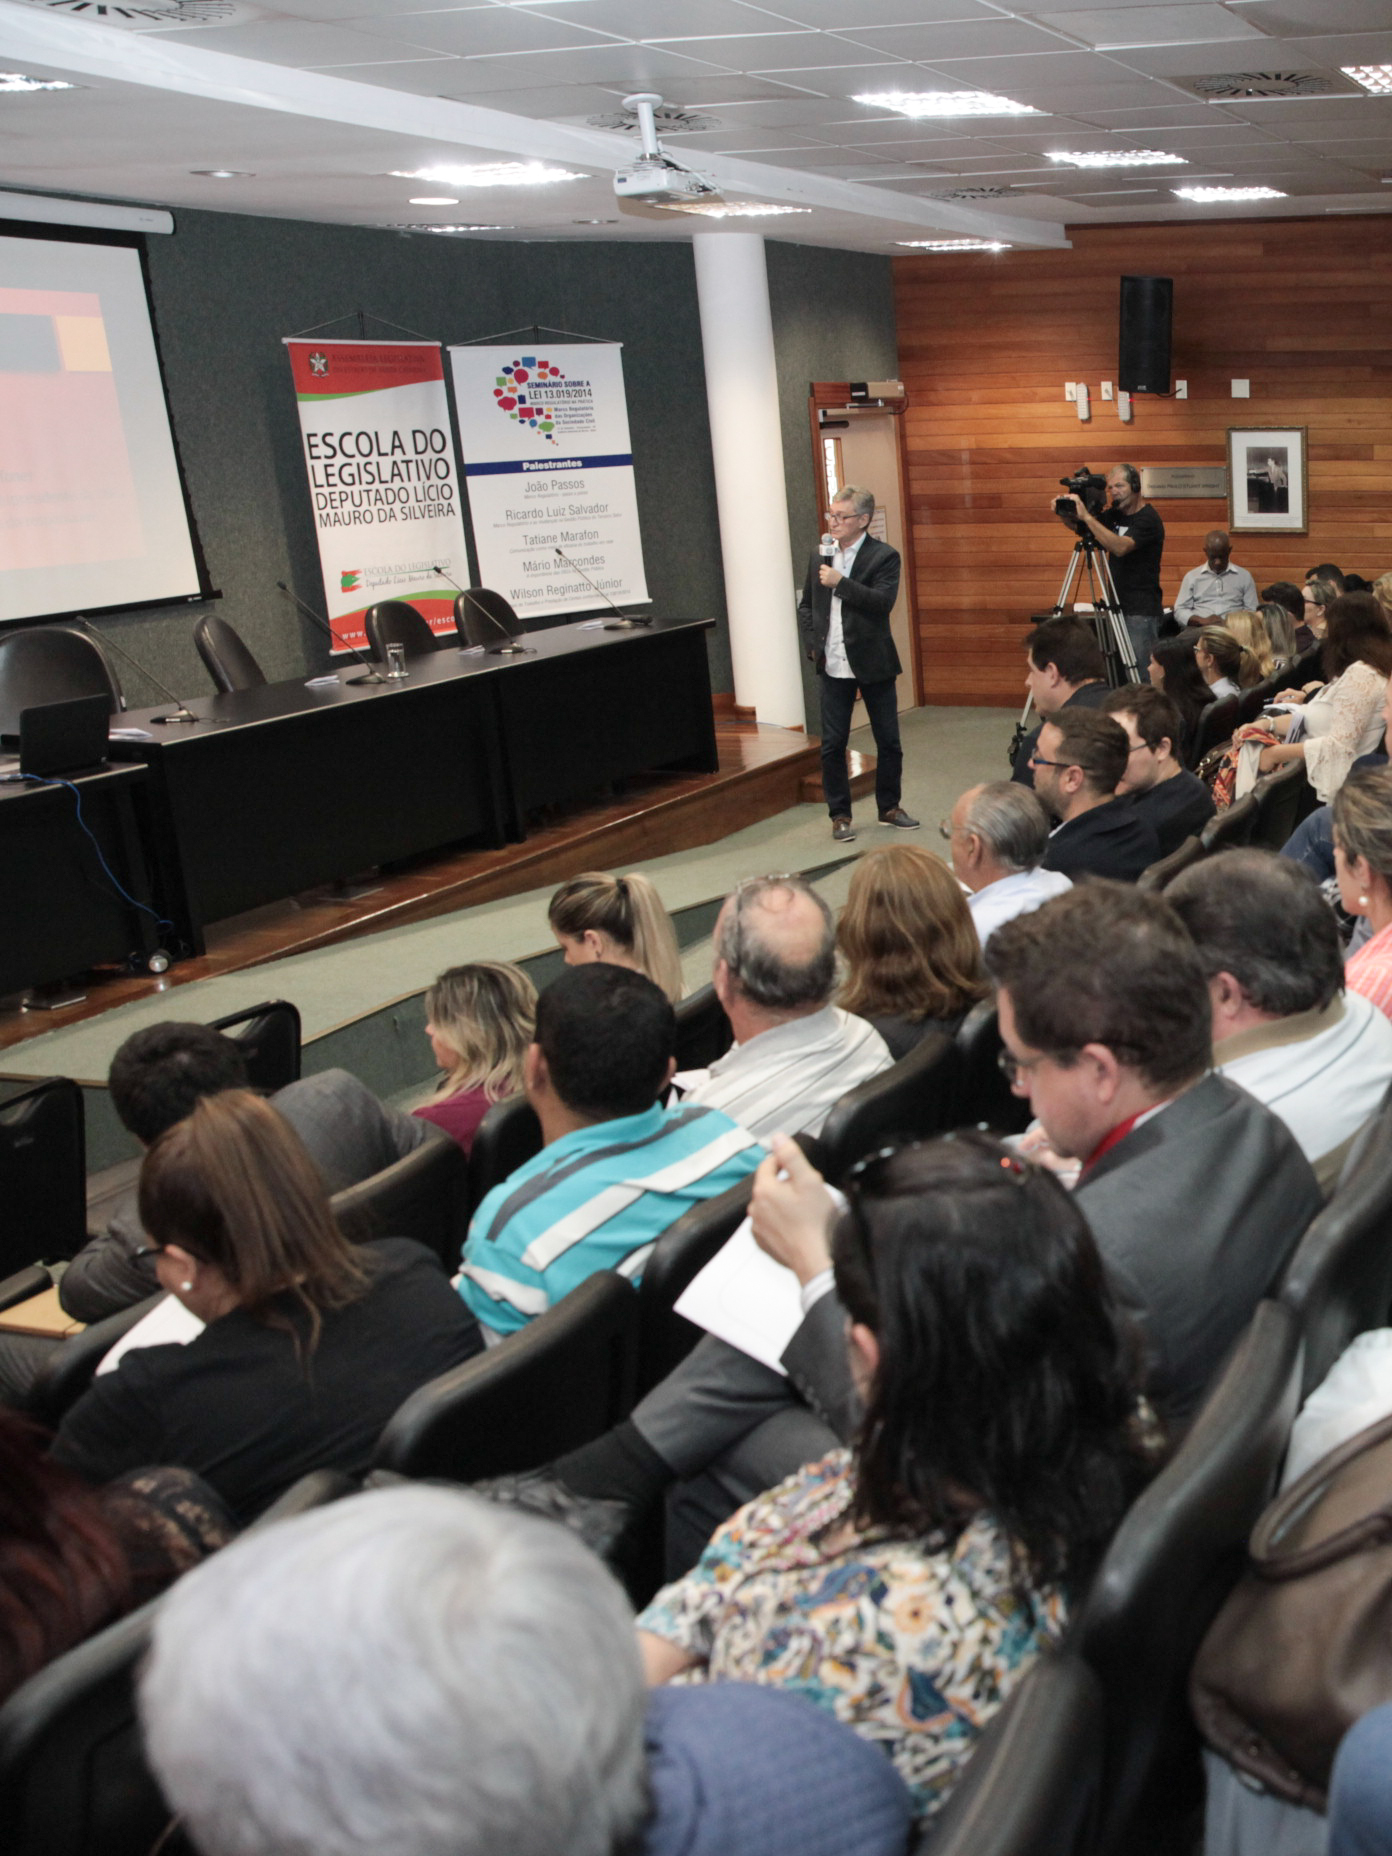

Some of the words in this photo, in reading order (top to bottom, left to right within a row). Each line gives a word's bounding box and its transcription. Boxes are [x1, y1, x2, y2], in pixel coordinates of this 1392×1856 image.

[527, 380, 562, 389] SEMINÁRIO
[528, 390, 542, 400] LEI
[544, 389, 592, 399] 13.019/2014
[306, 430, 406, 460] ESCOLA
[412, 428, 447, 455] DO
[311, 458, 450, 488] LEGISLATIVO
[522, 460, 583, 470] Palestrantes
[525, 481, 548, 493] João
[552, 480, 585, 490] Passos
[316, 486, 410, 511] DEPUTADO
[414, 482, 453, 503] LÍCIO
[319, 509, 374, 528] MAURO
[378, 508, 397, 523] DA
[401, 502, 456, 521] SILVEIRA
[505, 508, 543, 520] Ricardo
[546, 506, 566, 518] Luiz
[568, 503, 609, 516] Salvador
[523, 534, 557, 546] Tatiane
[560, 530, 599, 542] Marafon
[364, 566, 394, 576] ESCOLA
[395, 564, 407, 572] DO
[408, 559, 452, 570] LEGISLATIVO
[523, 561, 551, 572] Mário
[554, 555, 606, 569] Marcondes
[510, 588, 544, 600] Wilson
[547, 582, 591, 596] Reginatto
[595, 578, 623, 590] Júnior
[426, 616, 455, 626] r/esco
